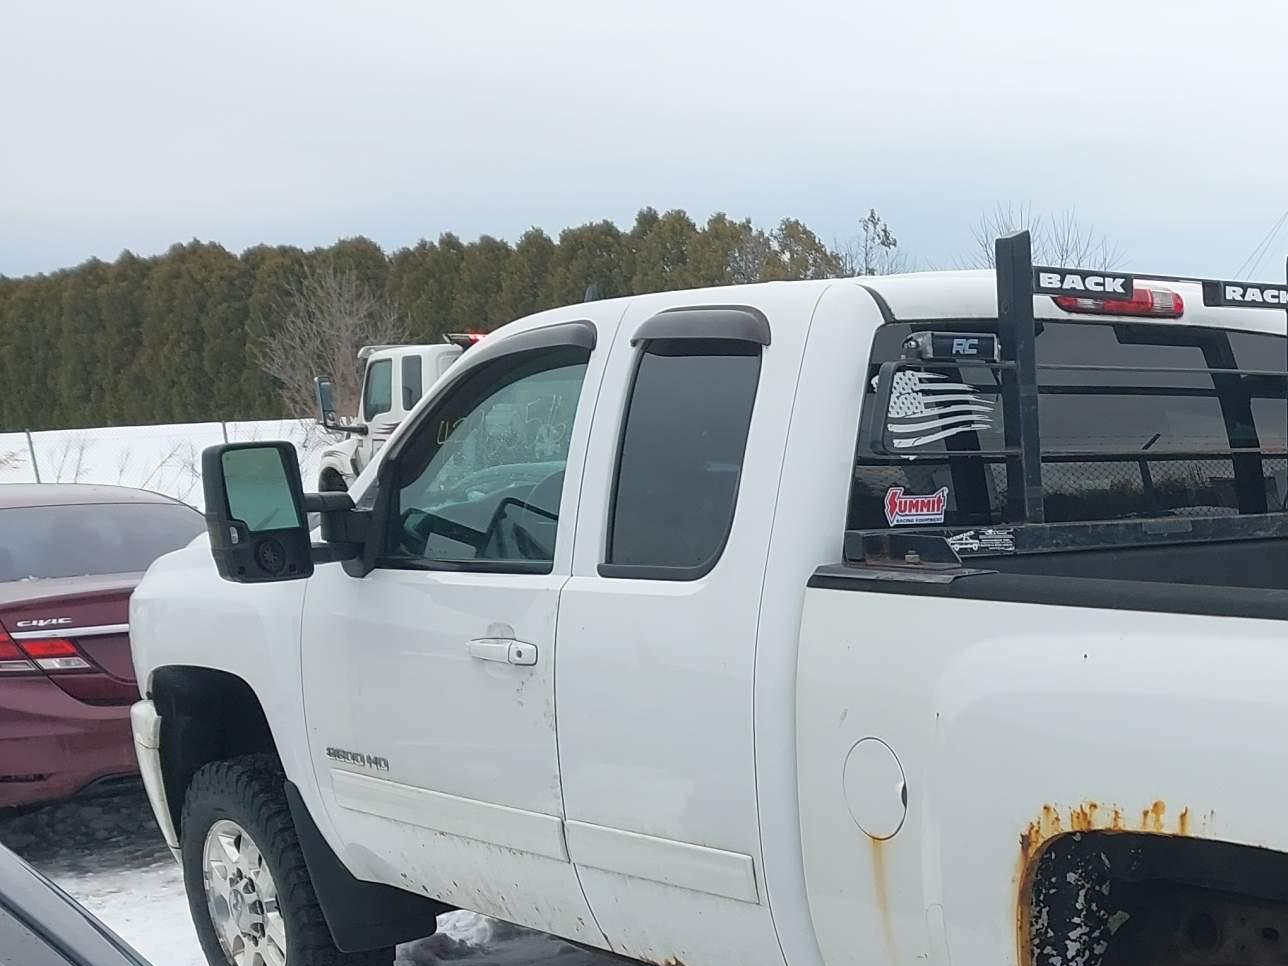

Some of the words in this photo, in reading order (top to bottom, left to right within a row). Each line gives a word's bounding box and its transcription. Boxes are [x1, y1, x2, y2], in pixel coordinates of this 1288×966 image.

[1039, 272, 1126, 293] BACK
[952, 338, 979, 355] RC
[888, 490, 945, 519] SUMMIT
[16, 617, 73, 628] CIVIC
